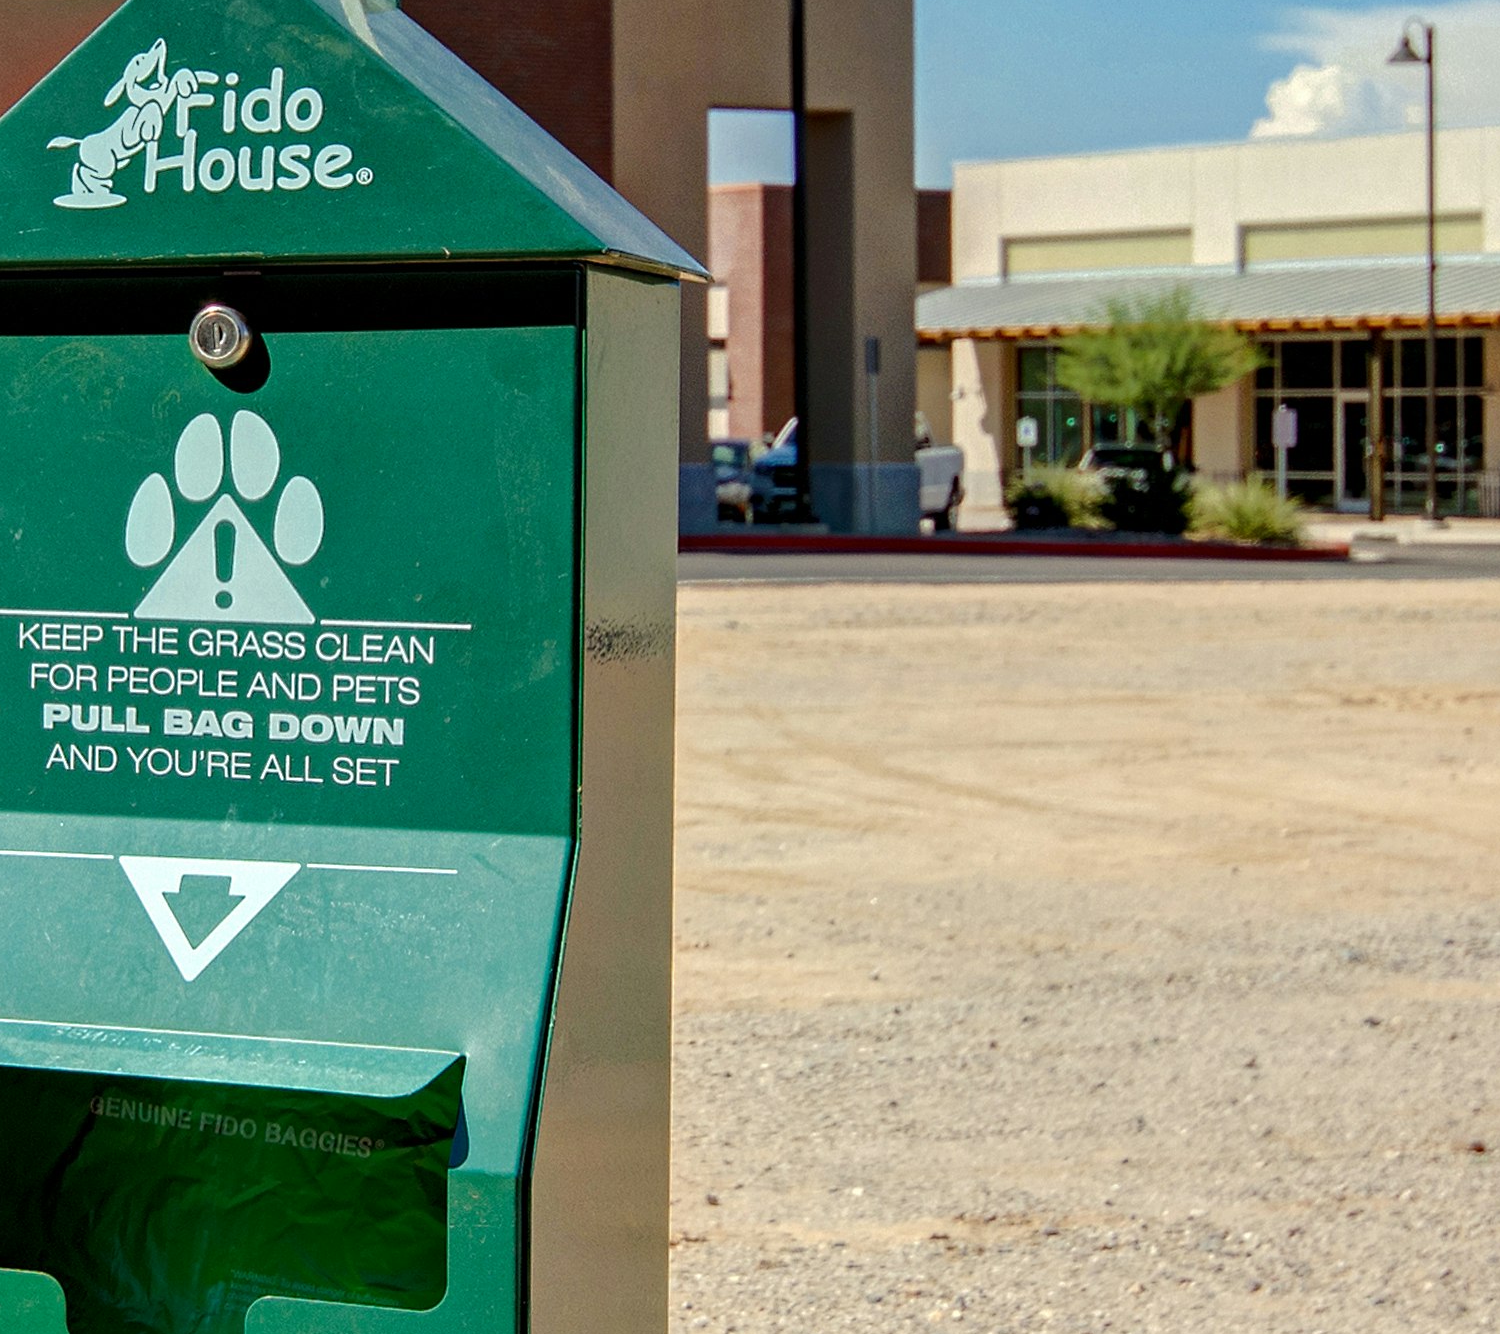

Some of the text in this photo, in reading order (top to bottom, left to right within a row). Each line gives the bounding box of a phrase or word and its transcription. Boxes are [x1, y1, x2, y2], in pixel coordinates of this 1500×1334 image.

[176, 66, 324, 138] Fido
[18, 622, 435, 665] KEEP THE GRASS CLEAN
[30, 662, 421, 706] FOR PEOPLE AND PETS
[43, 702, 405, 746] PULL BAG DOWN
[45, 742, 400, 787] AND YOU'RE ALL SET
[90, 1095, 192, 1130] GENUINE
[199, 1111, 257, 1139] FIDO
